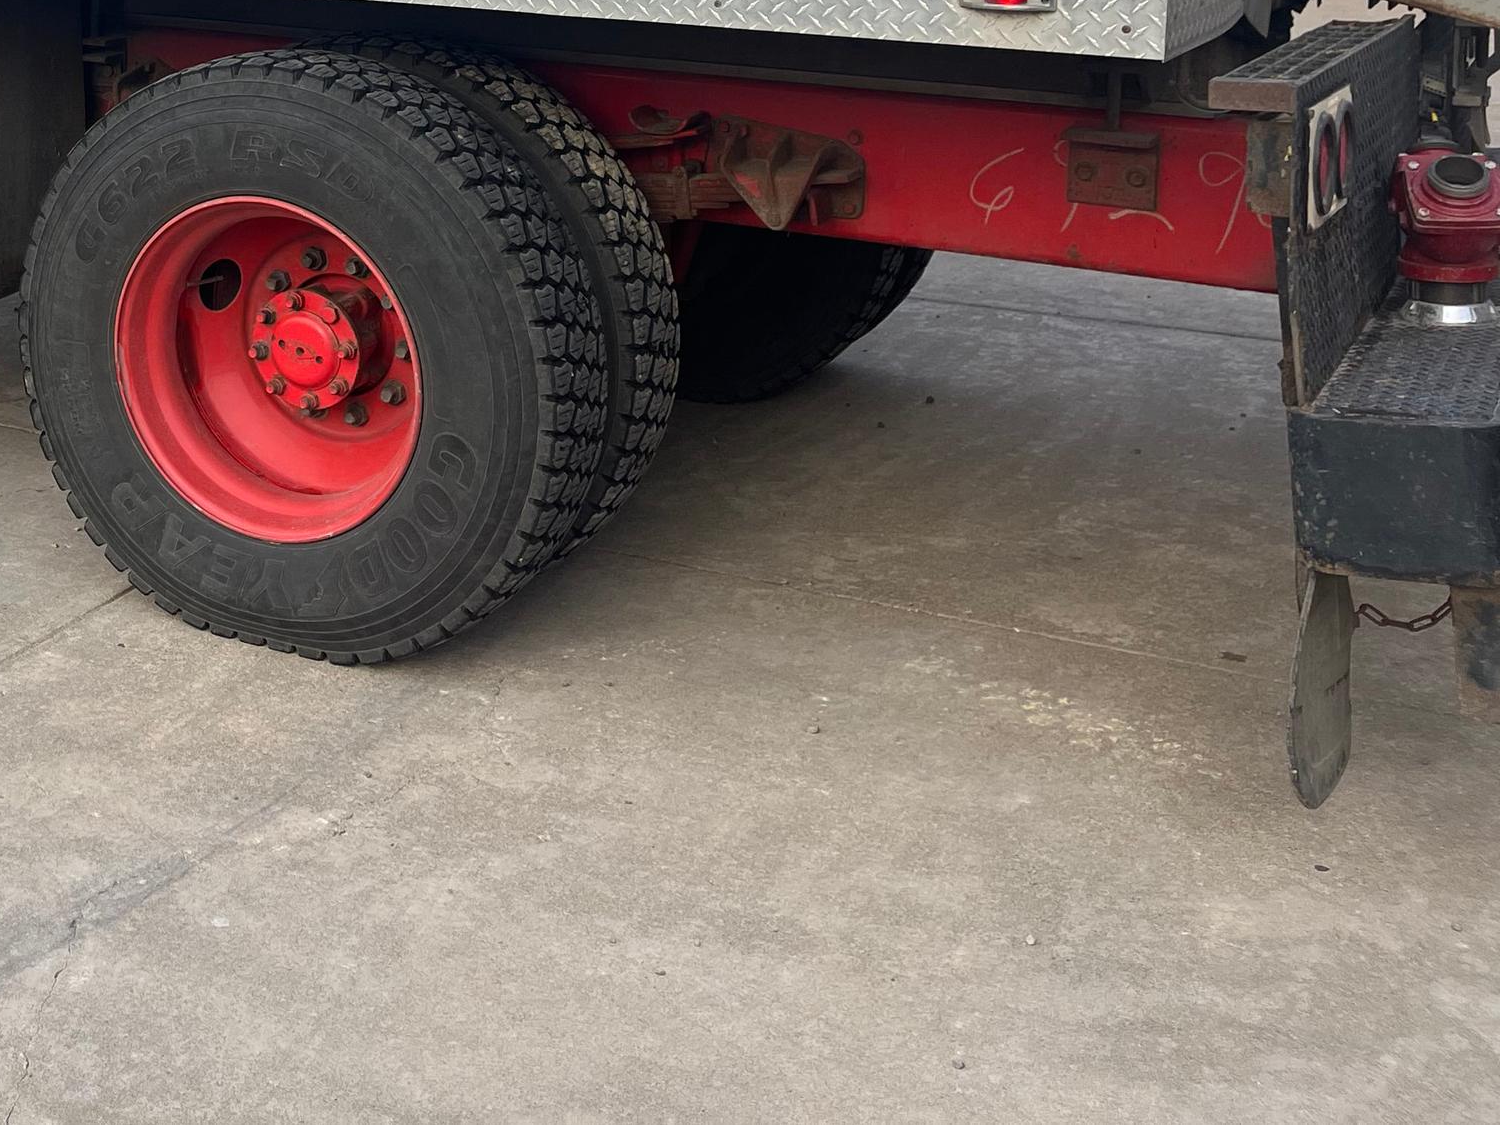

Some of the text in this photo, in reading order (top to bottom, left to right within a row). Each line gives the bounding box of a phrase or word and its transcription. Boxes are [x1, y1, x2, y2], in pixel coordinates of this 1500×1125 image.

[75, 130, 375, 264] G622 RSD
[111, 431, 478, 617] GOODYEAR
